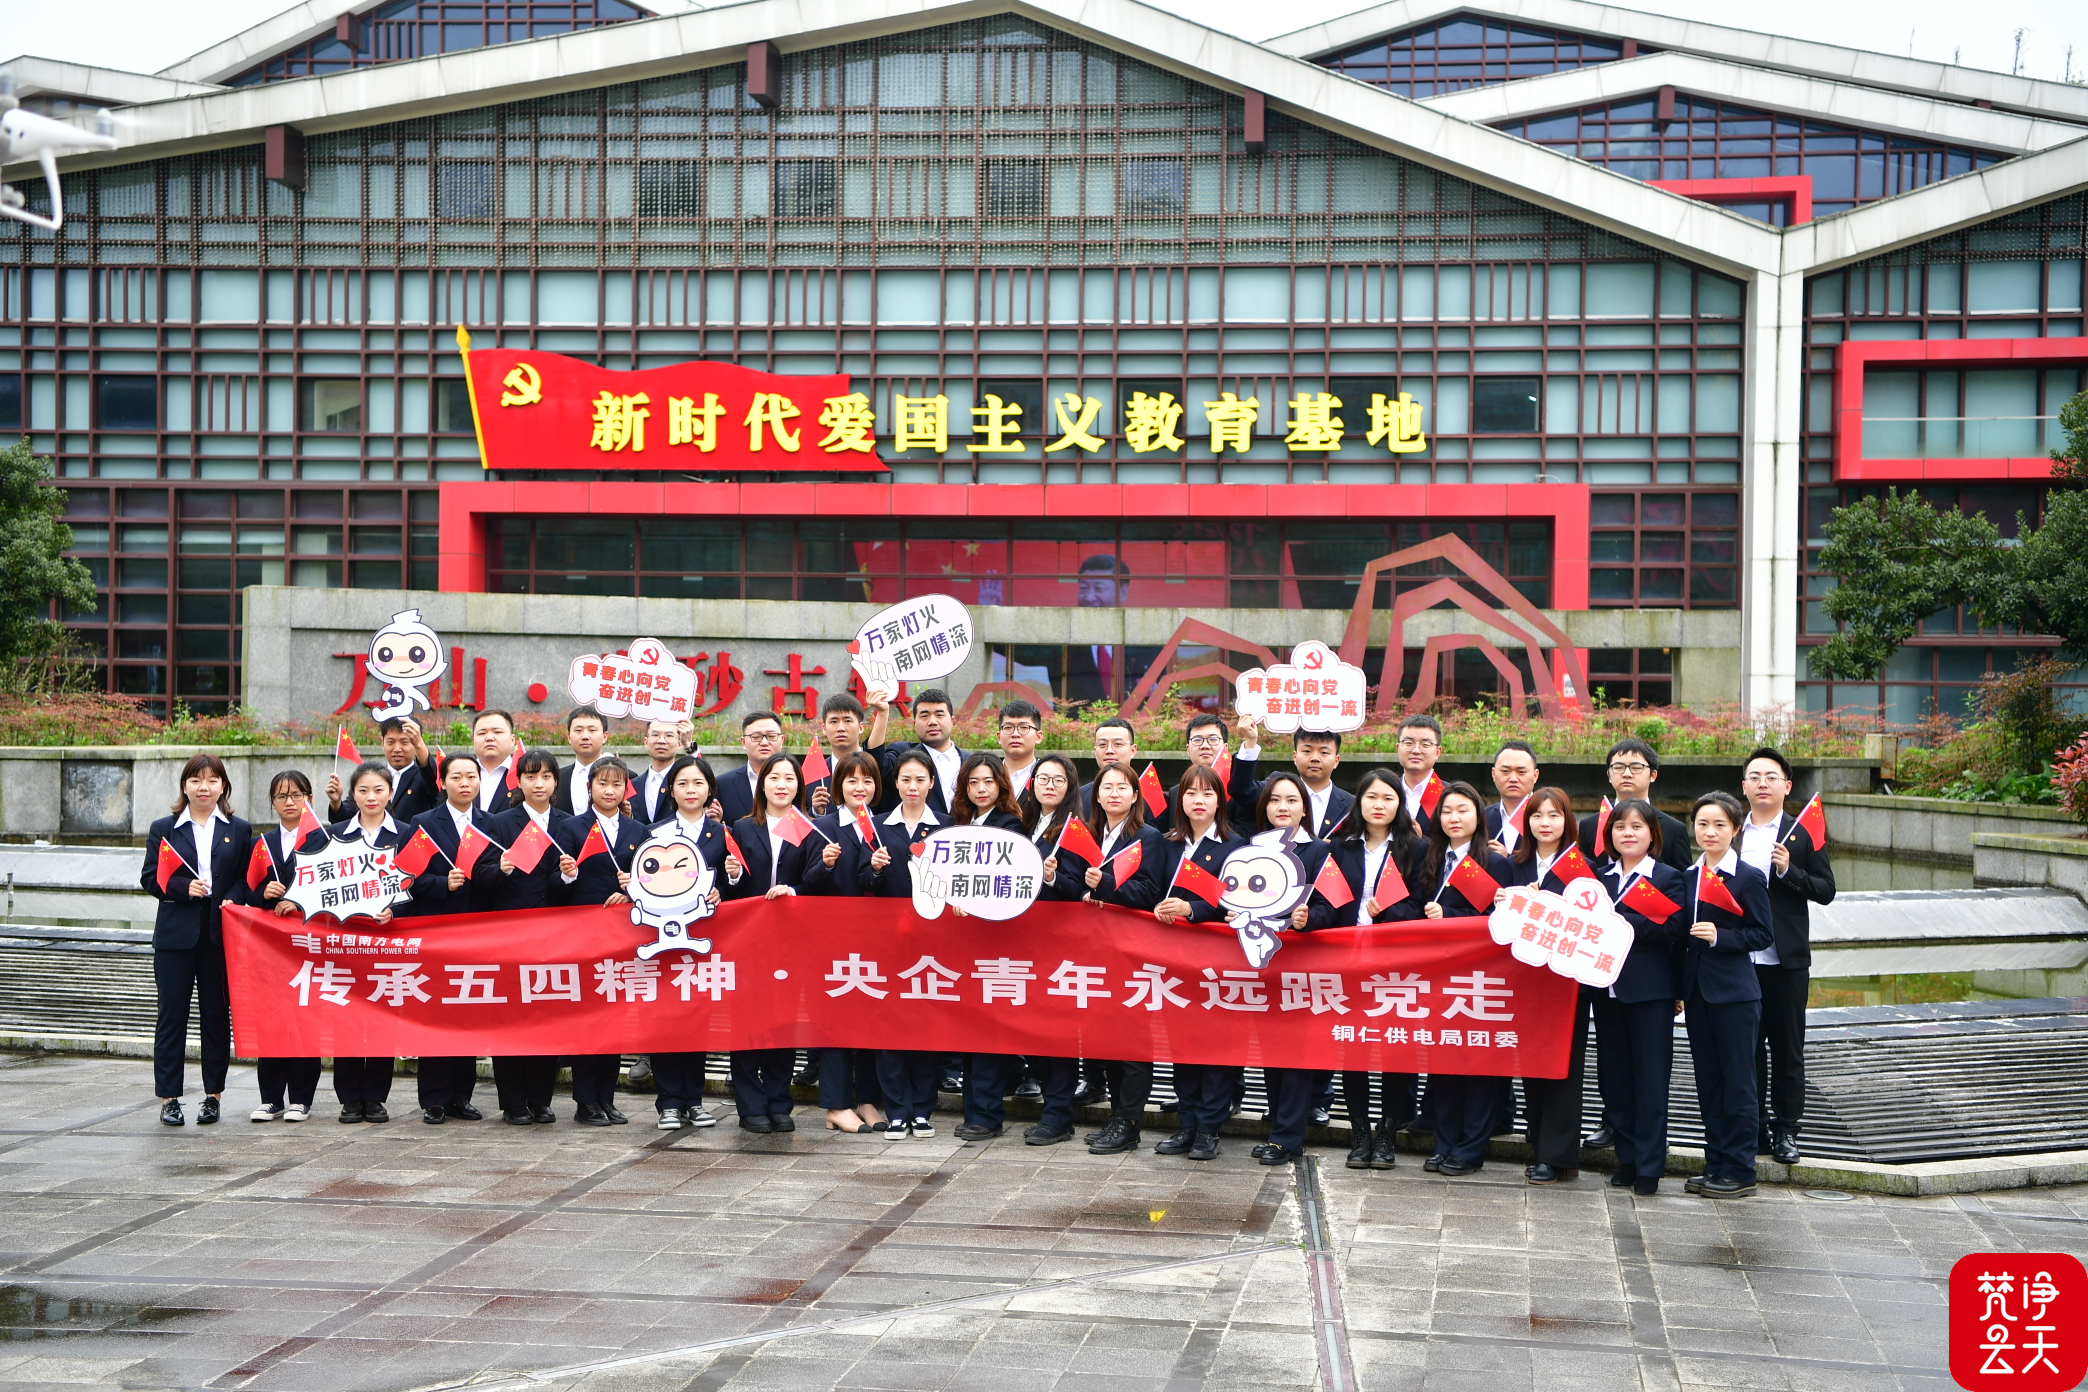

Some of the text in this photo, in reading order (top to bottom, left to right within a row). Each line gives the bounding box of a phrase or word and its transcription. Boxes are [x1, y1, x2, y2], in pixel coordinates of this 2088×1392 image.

[590, 390, 1427, 455] 新时代爱国主义教育基地
[864, 604, 940, 654] 万家灯火
[893, 623, 969, 674] 南网情深
[582, 661, 672, 692] 青春心向党
[1247, 677, 1339, 696] 青春心向党
[598, 683, 688, 713] 奋进创一流
[1266, 697, 1359, 717] 奋进创一流
[931, 840, 1014, 866] 万家灯火
[295, 852, 377, 887] 万家灯火
[320, 874, 401, 909] 南网情深
[951, 873, 1034, 899] 南网情深
[1508, 893, 1604, 945] 青春心向党
[325, 947, 419, 955] CHINA SOUTHERN POWER GRID
[326, 933, 423, 948] 中国南方电网
[1519, 921, 1616, 974] 奋进创一流
[289, 952, 1515, 1022] 传承五四精神·央企青年永远跟党走
[1331, 1024, 1520, 1049] 铜仁供电局团委
